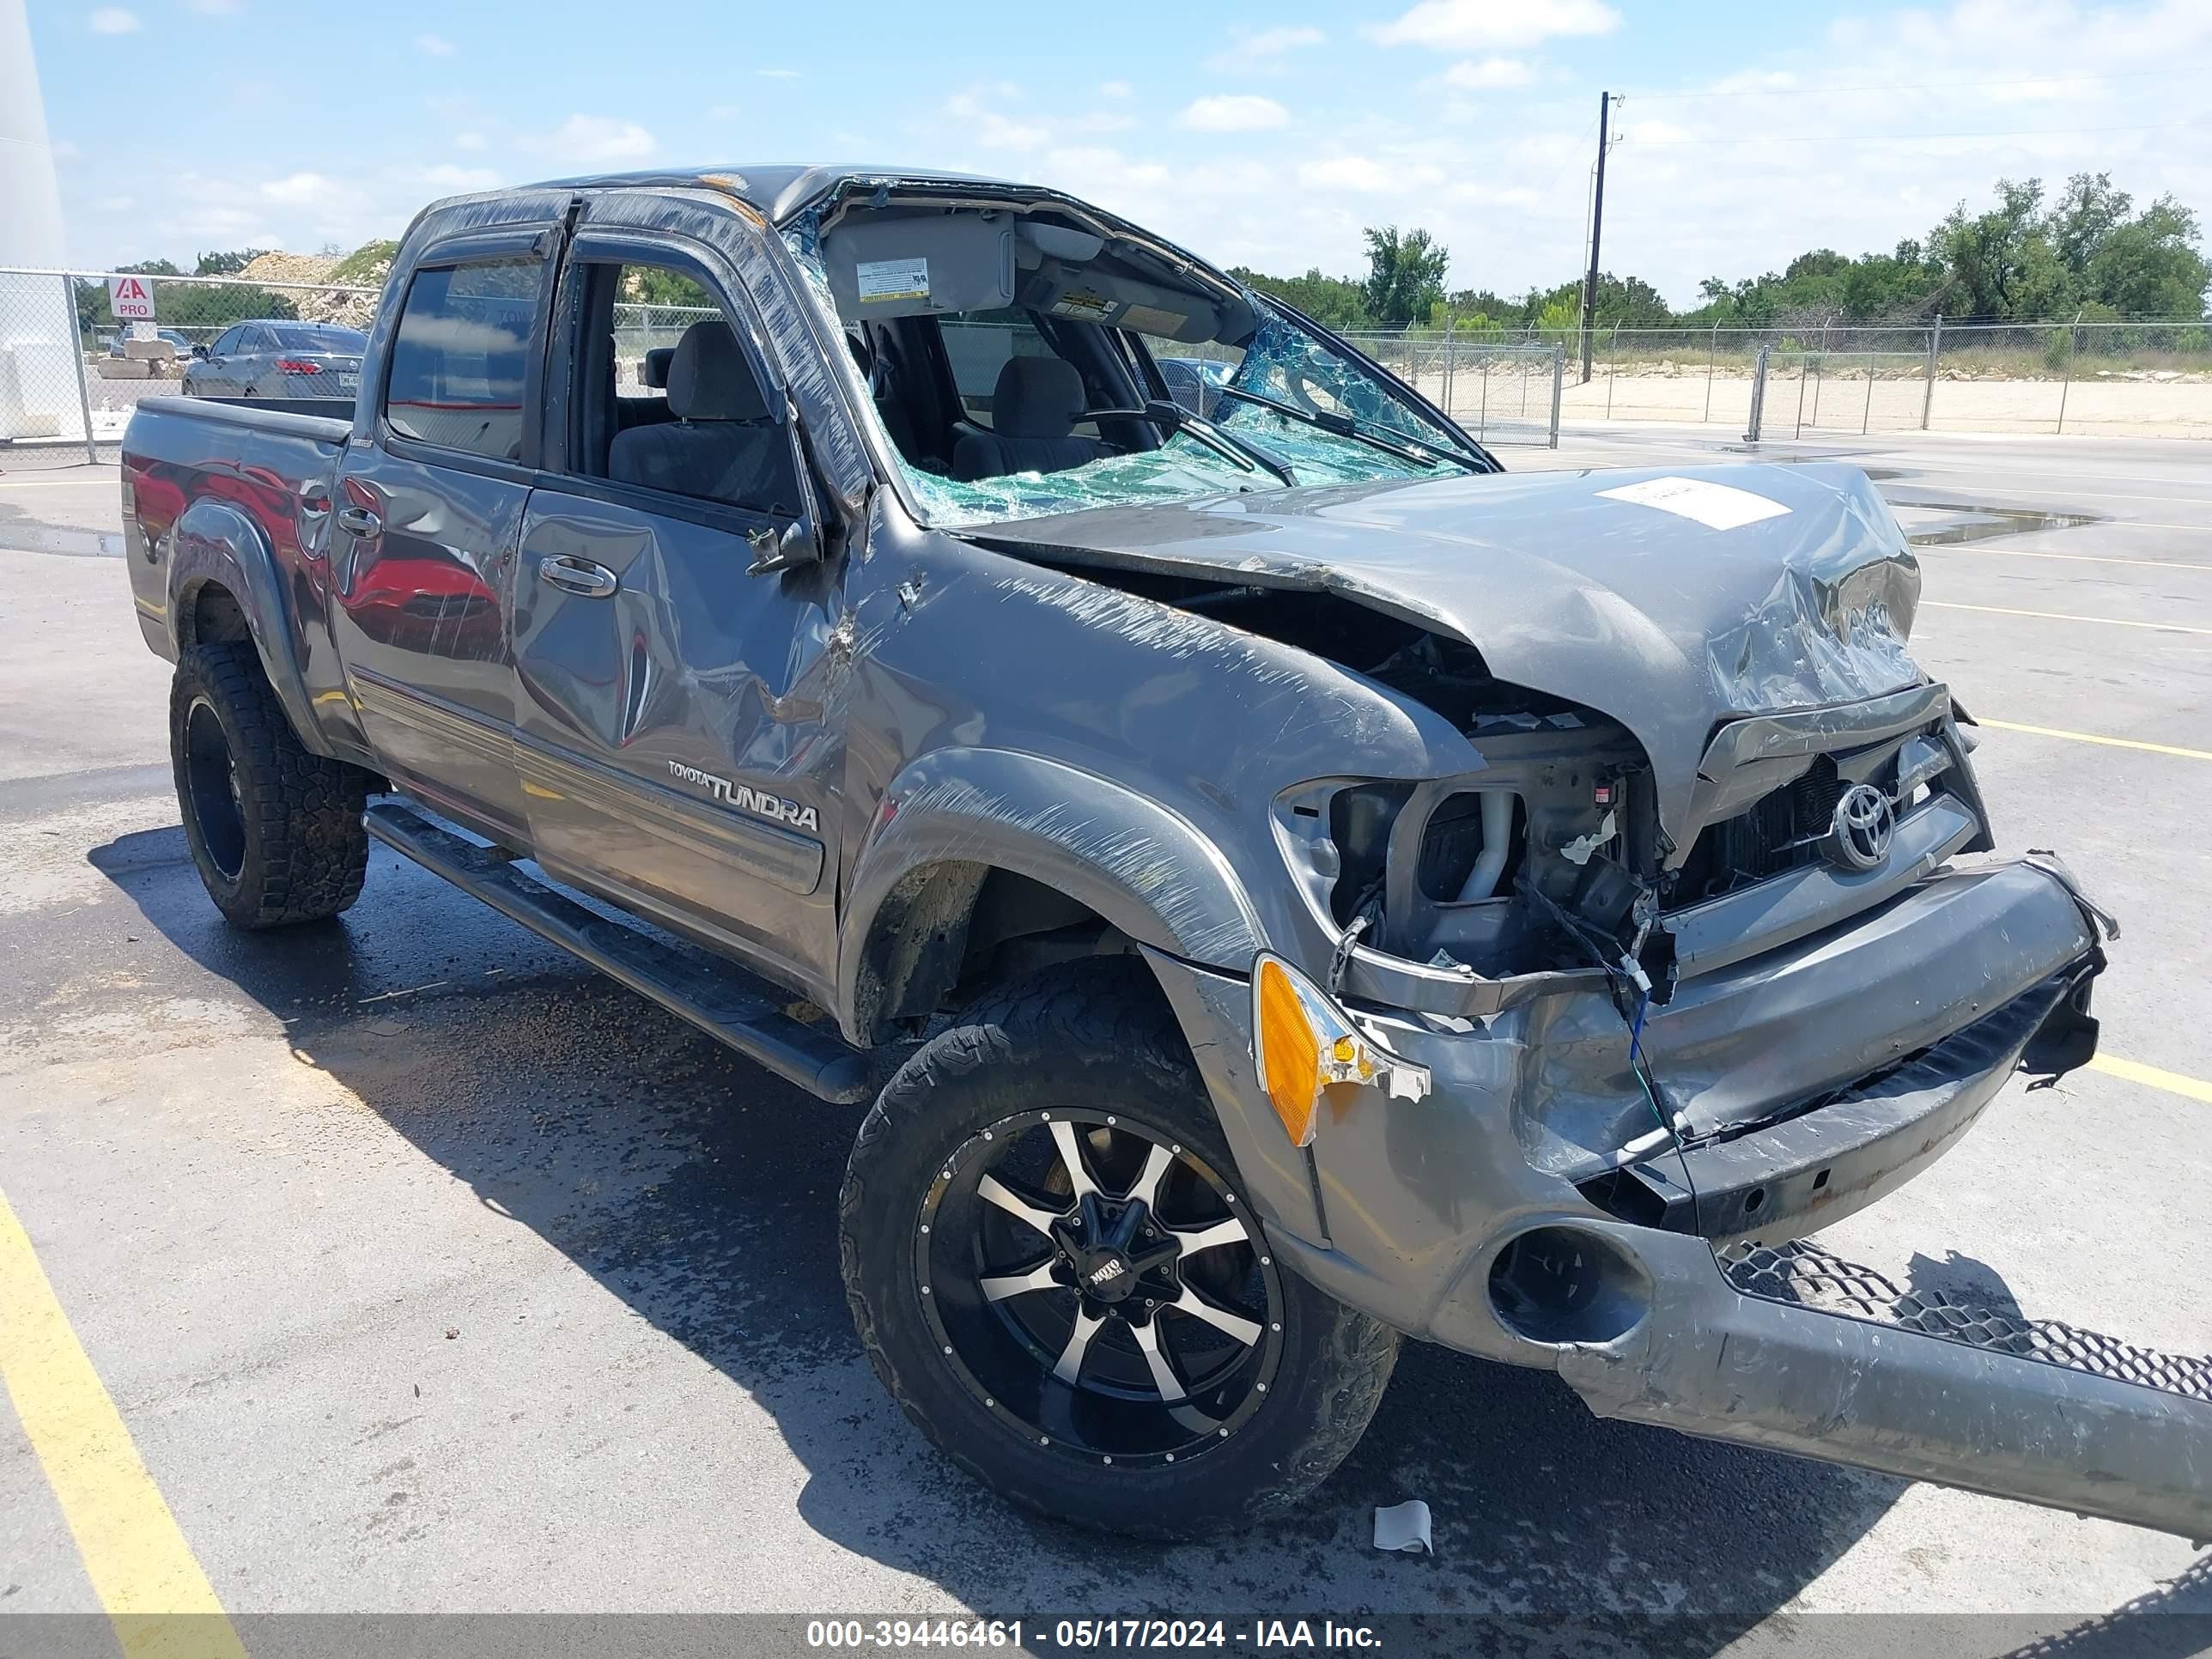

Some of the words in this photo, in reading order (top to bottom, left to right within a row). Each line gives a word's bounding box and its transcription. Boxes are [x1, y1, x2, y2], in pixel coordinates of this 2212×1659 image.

[119, 304, 148, 315] PRO
[668, 760, 710, 788] TOYOTA
[708, 775, 819, 832] TUNDRA
[1090, 1259, 1120, 1285] MOTO
[1104, 1267, 1125, 1281] METAL
